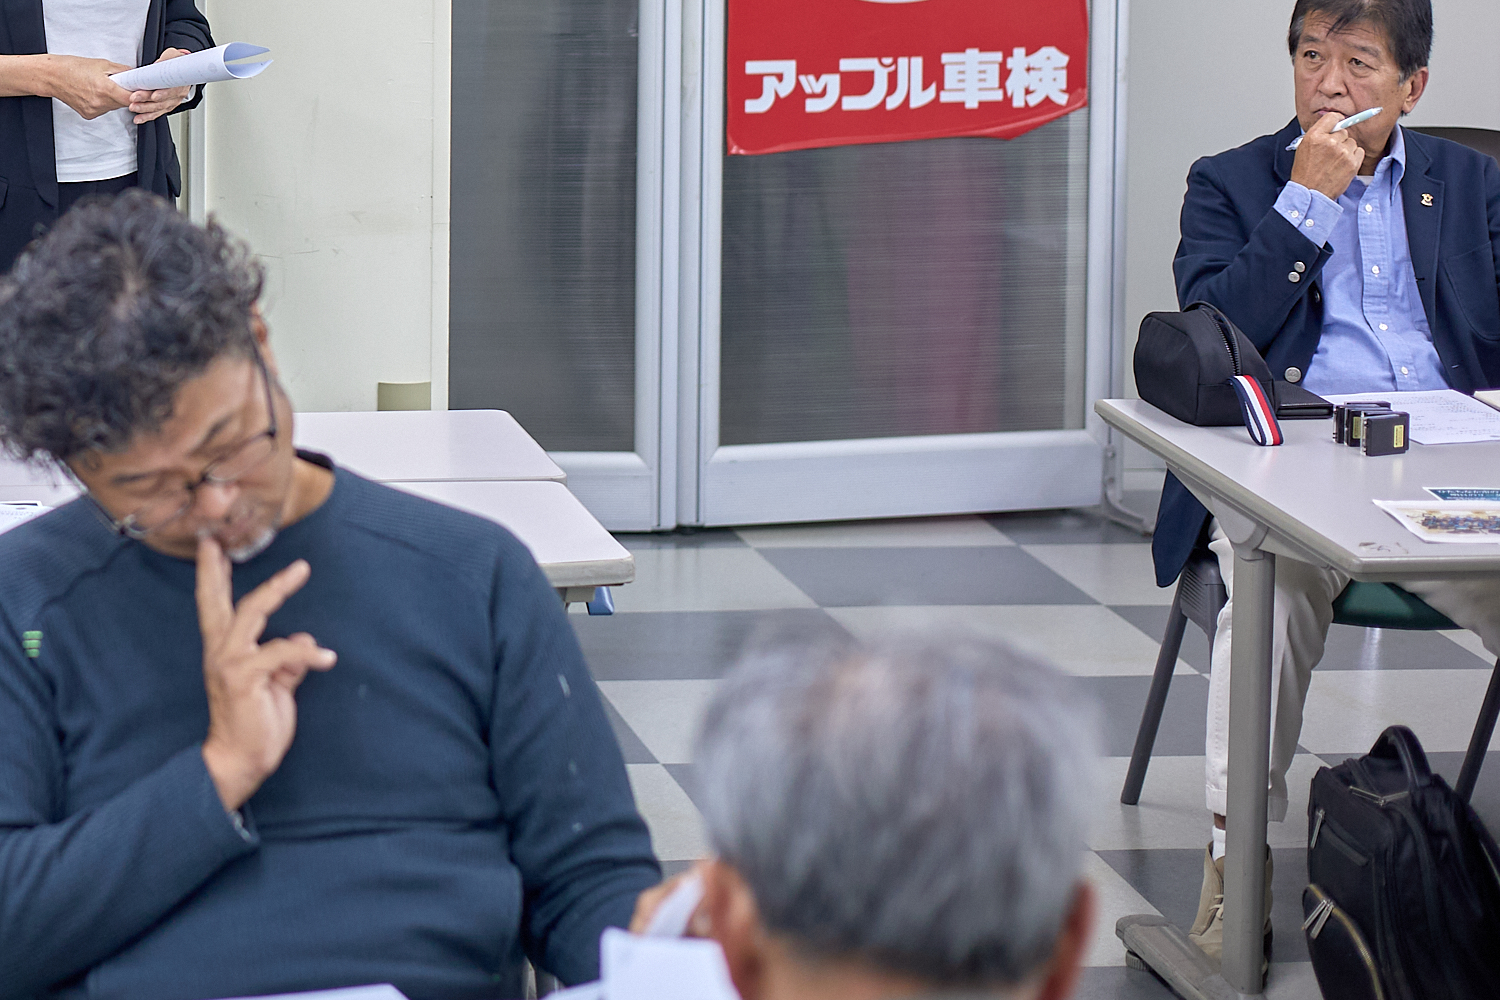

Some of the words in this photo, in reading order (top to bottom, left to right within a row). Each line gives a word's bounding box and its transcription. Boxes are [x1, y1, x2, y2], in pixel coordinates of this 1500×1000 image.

[744, 46, 1070, 113] アップル車検
